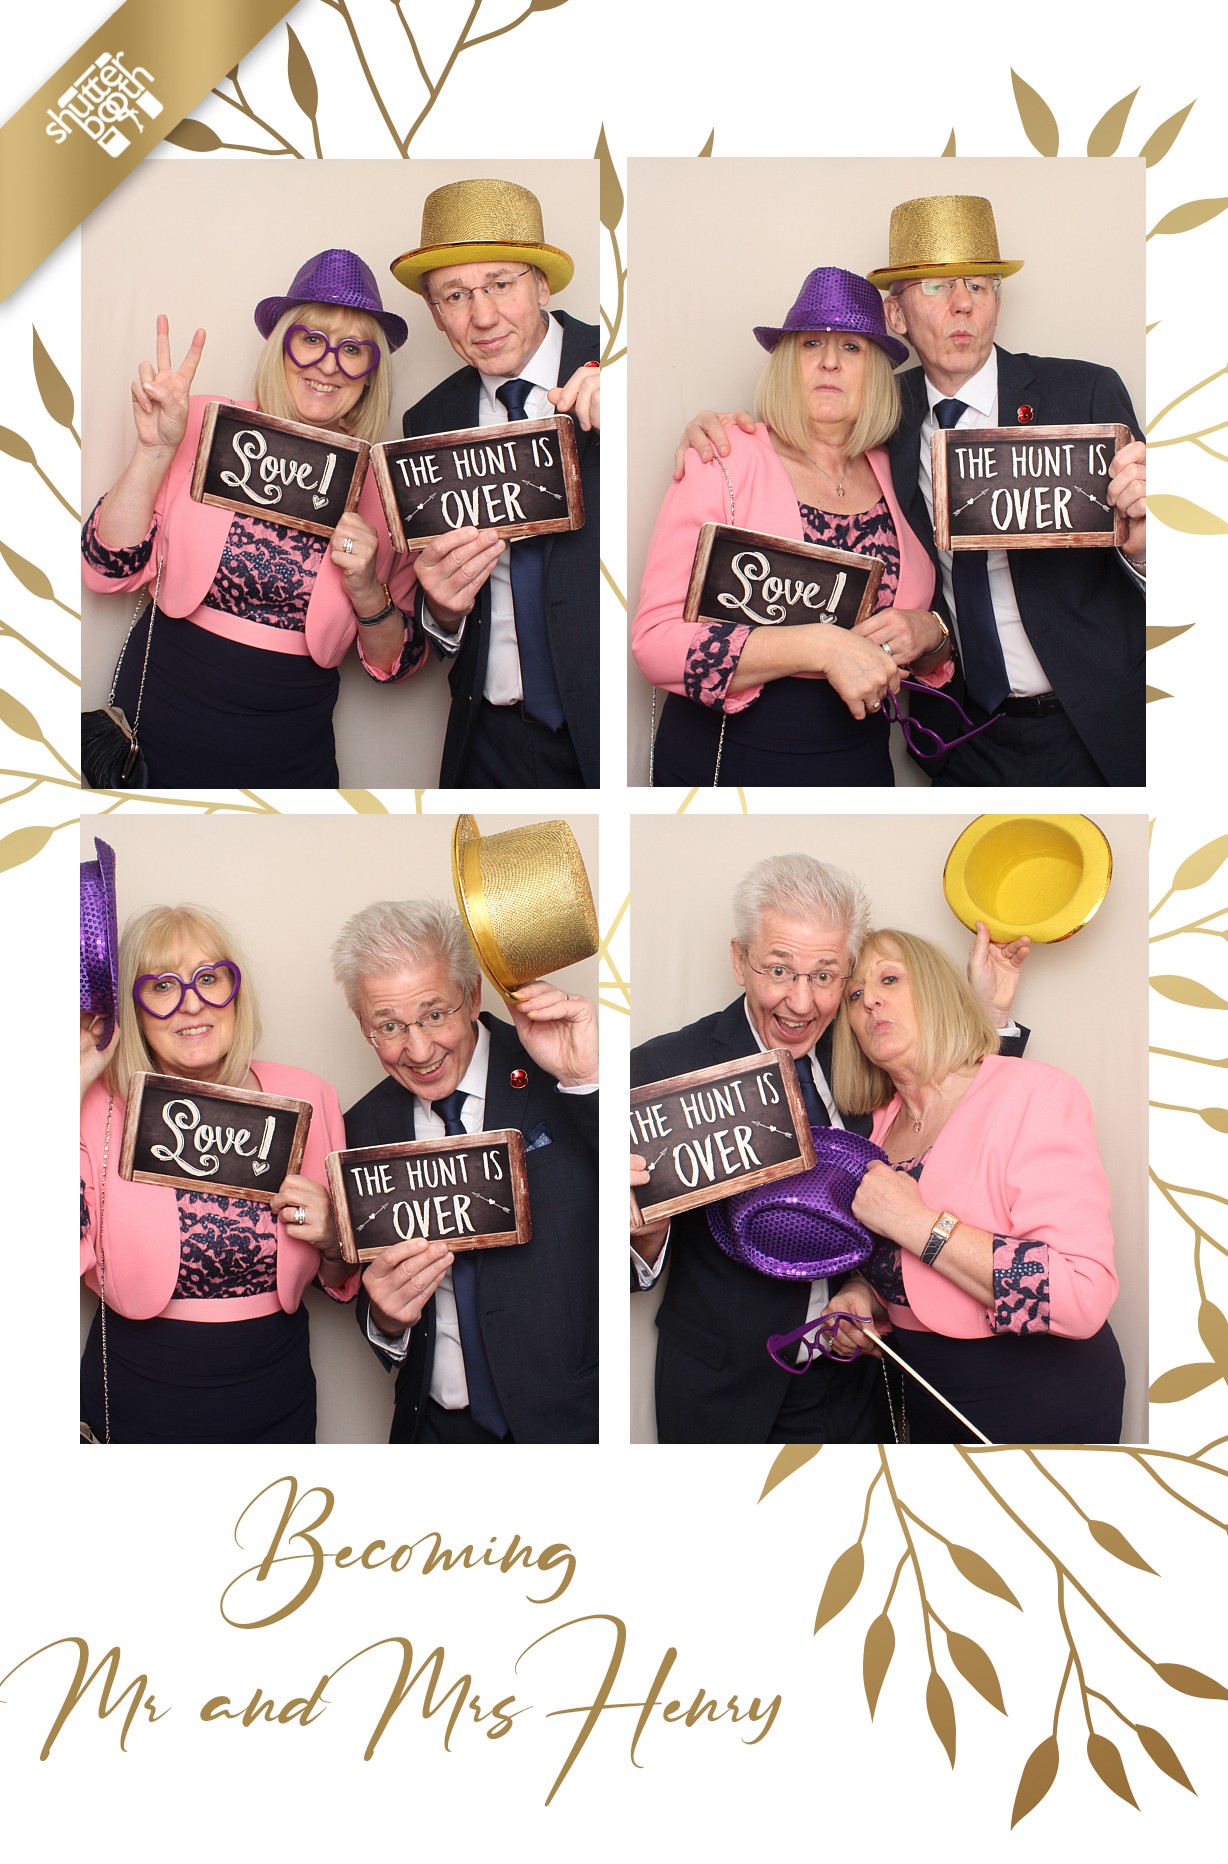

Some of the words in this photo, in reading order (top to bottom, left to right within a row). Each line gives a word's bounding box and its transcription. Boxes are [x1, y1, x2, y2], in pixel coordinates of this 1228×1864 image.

[219, 430, 337, 505] Love!
[396, 454, 443, 488] THE
[452, 441, 517, 481] HUNT
[531, 437, 554, 468] IS
[954, 447, 999, 480] THE
[1011, 444, 1075, 479] HUNT
[1088, 443, 1107, 476] IS
[440, 482, 527, 530] OVER
[990, 486, 1074, 531] OVER
[716, 551, 848, 624] Love!
[679, 1080, 746, 1130] HUNT
[755, 1072, 780, 1106] IS
[150, 1099, 276, 1177] Love!
[672, 1125, 763, 1188] OVER
[350, 1164, 396, 1197] THE
[405, 1153, 469, 1191] HUNT
[482, 1150, 503, 1181] IS
[392, 1194, 476, 1239] OVER
